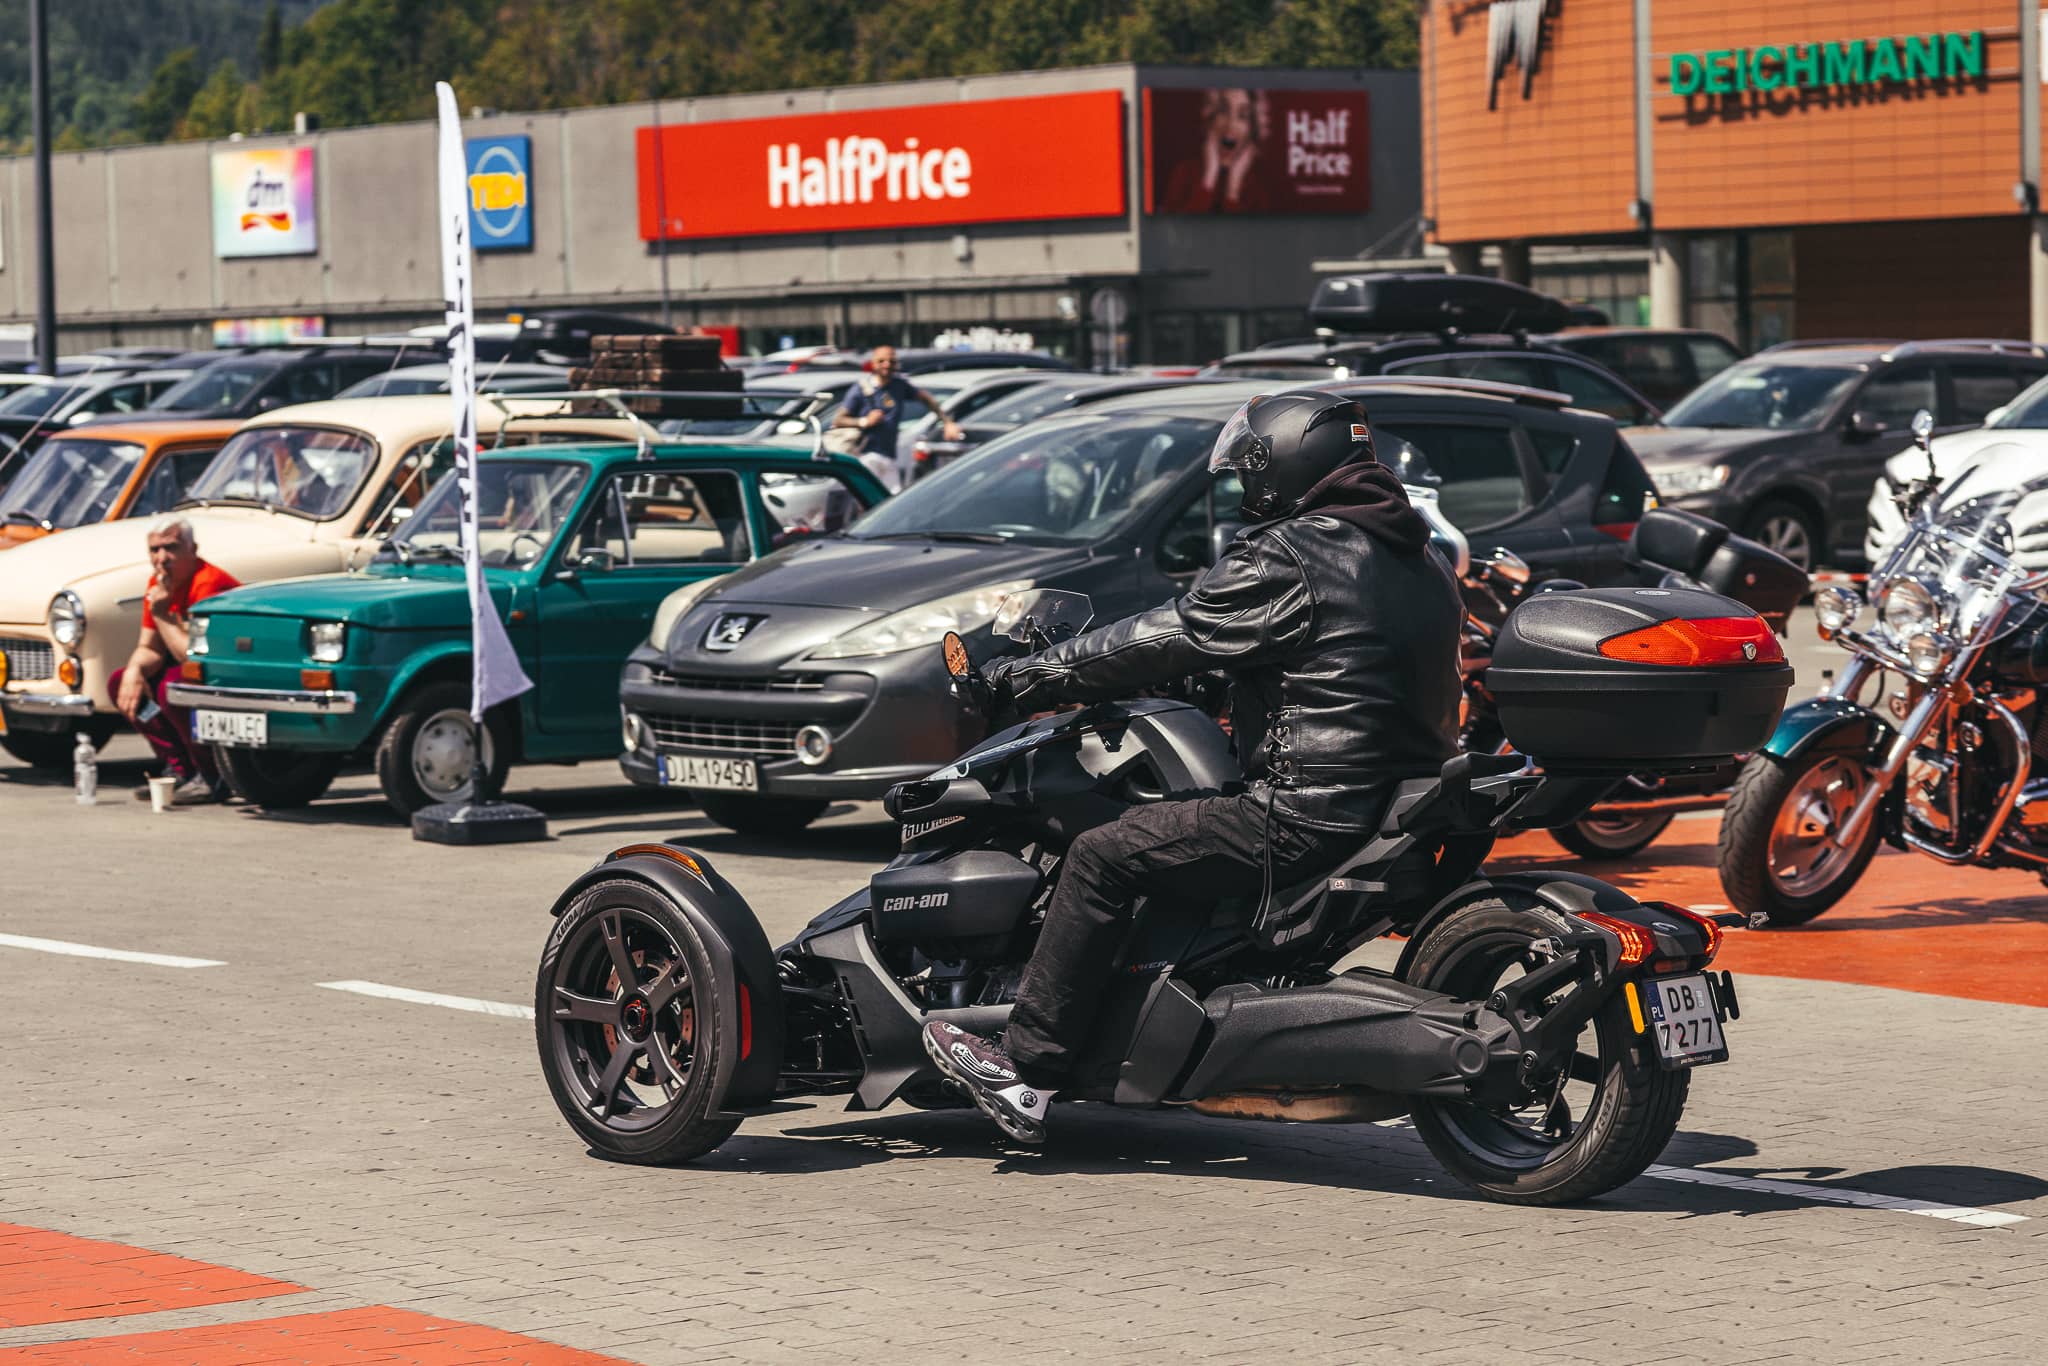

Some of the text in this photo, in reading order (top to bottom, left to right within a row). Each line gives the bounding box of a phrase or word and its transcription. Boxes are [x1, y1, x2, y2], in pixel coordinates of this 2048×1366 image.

[1670, 31, 1984, 96] DEICHMANN
[1287, 110, 1349, 145] Half
[767, 135, 972, 208] HalfPrice
[1287, 146, 1351, 176] Price
[247, 170, 284, 208] dm
[665, 756, 755, 787] DJA 19450
[883, 892, 949, 912] can-am
[555, 908, 580, 942] KENDA
[1651, 1005, 1665, 1020] PL
[1666, 984, 1696, 1014] DB
[1659, 1016, 1713, 1052] 7277
[980, 1059, 1017, 1080] can-am
